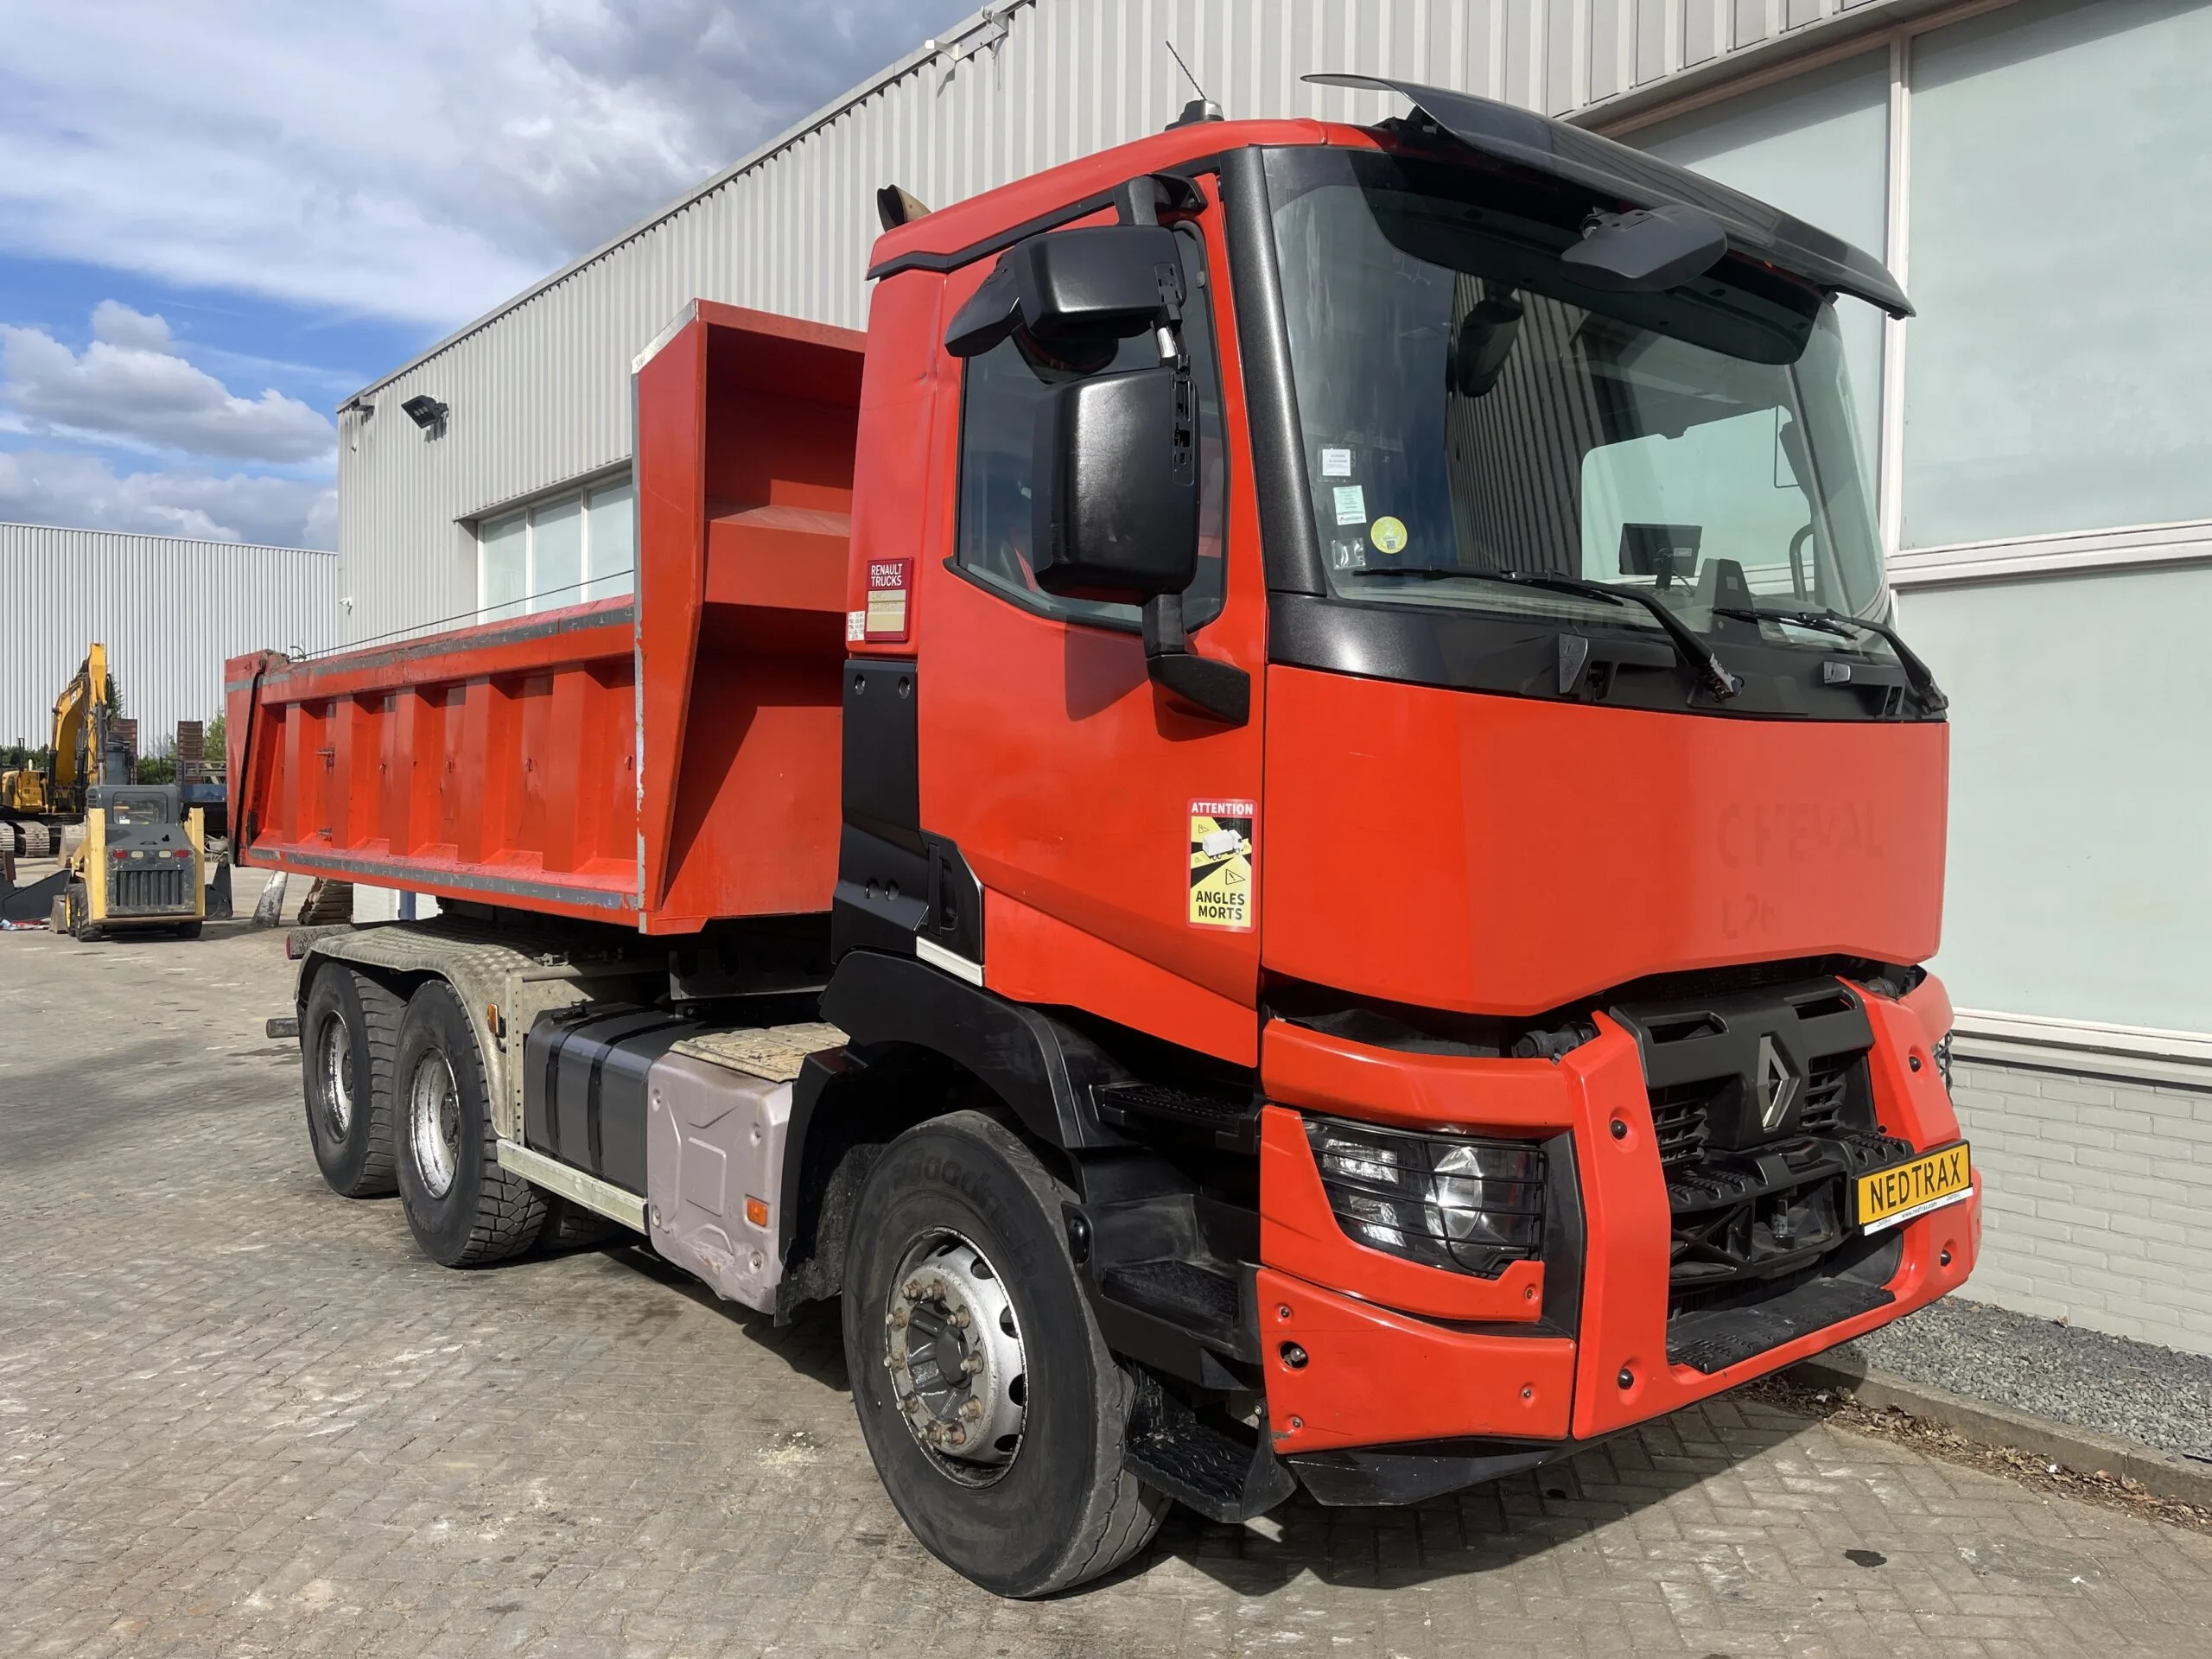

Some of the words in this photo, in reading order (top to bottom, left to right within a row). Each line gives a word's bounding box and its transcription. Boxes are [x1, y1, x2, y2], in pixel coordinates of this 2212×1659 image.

[871, 563, 903, 576] RENAULT
[871, 575, 902, 588] TRUCKS
[1192, 802, 1253, 816] ATTENTION
[1196, 890, 1245, 906] ANGLES
[1198, 905, 1243, 920] MORTS
[1870, 1152, 1961, 1214] NEDTRAX
